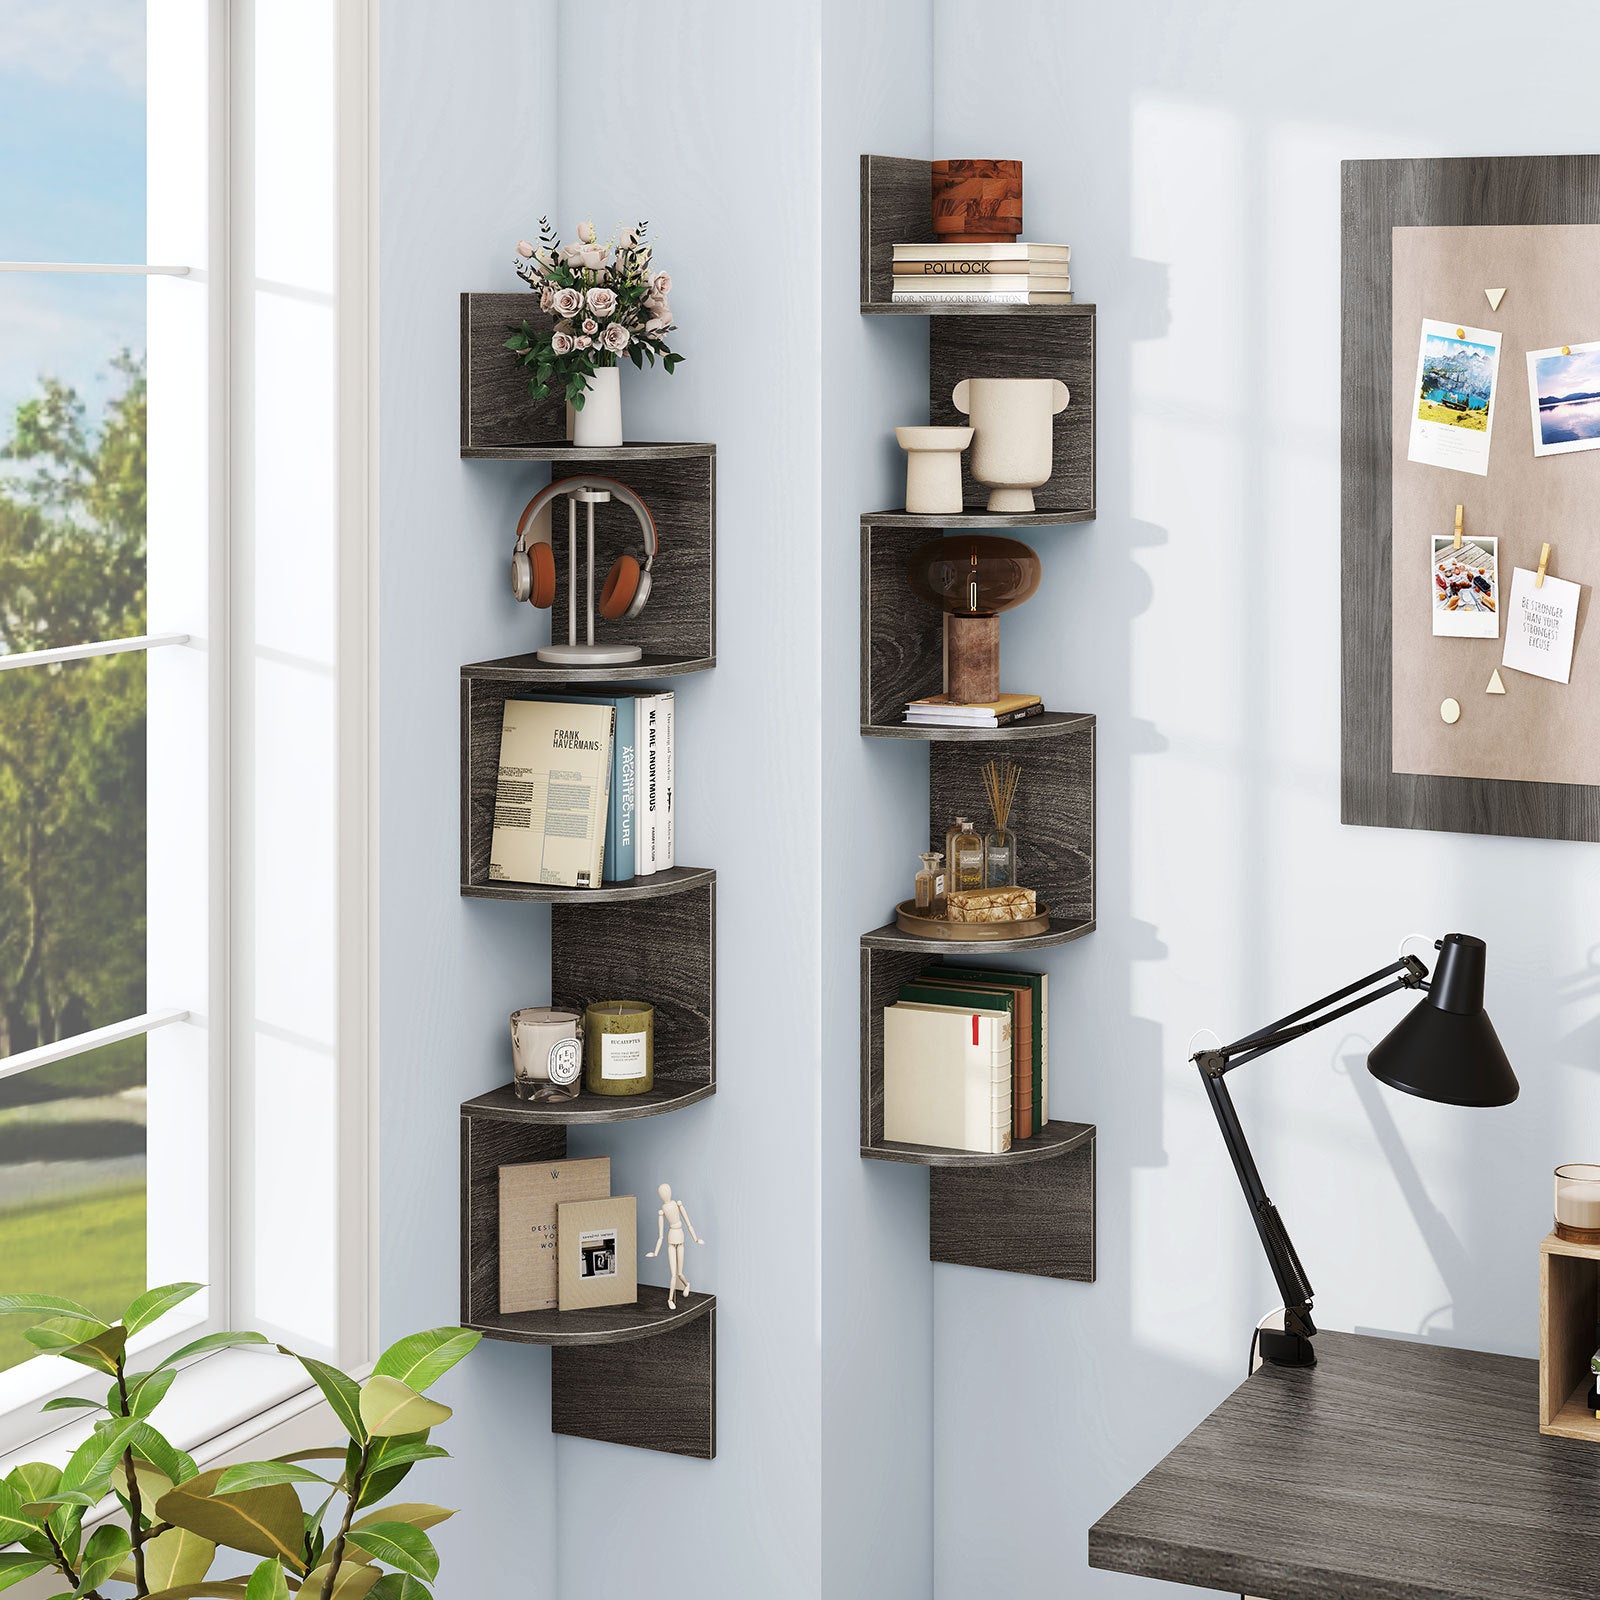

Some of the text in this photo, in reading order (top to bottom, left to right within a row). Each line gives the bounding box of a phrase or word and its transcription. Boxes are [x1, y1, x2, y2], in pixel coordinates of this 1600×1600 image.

[924, 262, 991, 275] POLLOCK
[918, 295, 939, 303] NEW
[940, 295, 964, 303] LOOK
[966, 295, 1022, 303] REVOLUTION
[1521, 596, 1564, 618] BE STRONGER
[1524, 610, 1560, 630] THAN YOUR
[1522, 622, 1558, 641] STRONGEST
[1528, 636, 1551, 651] EXCUSE
[649, 710, 656, 727] WE
[553, 729, 580, 741] FRANK
[552, 739, 603, 751] HAVERMANS:
[622, 745, 630, 847] ARCHITECTURE
[531, 1223, 558, 1232] DESIG
